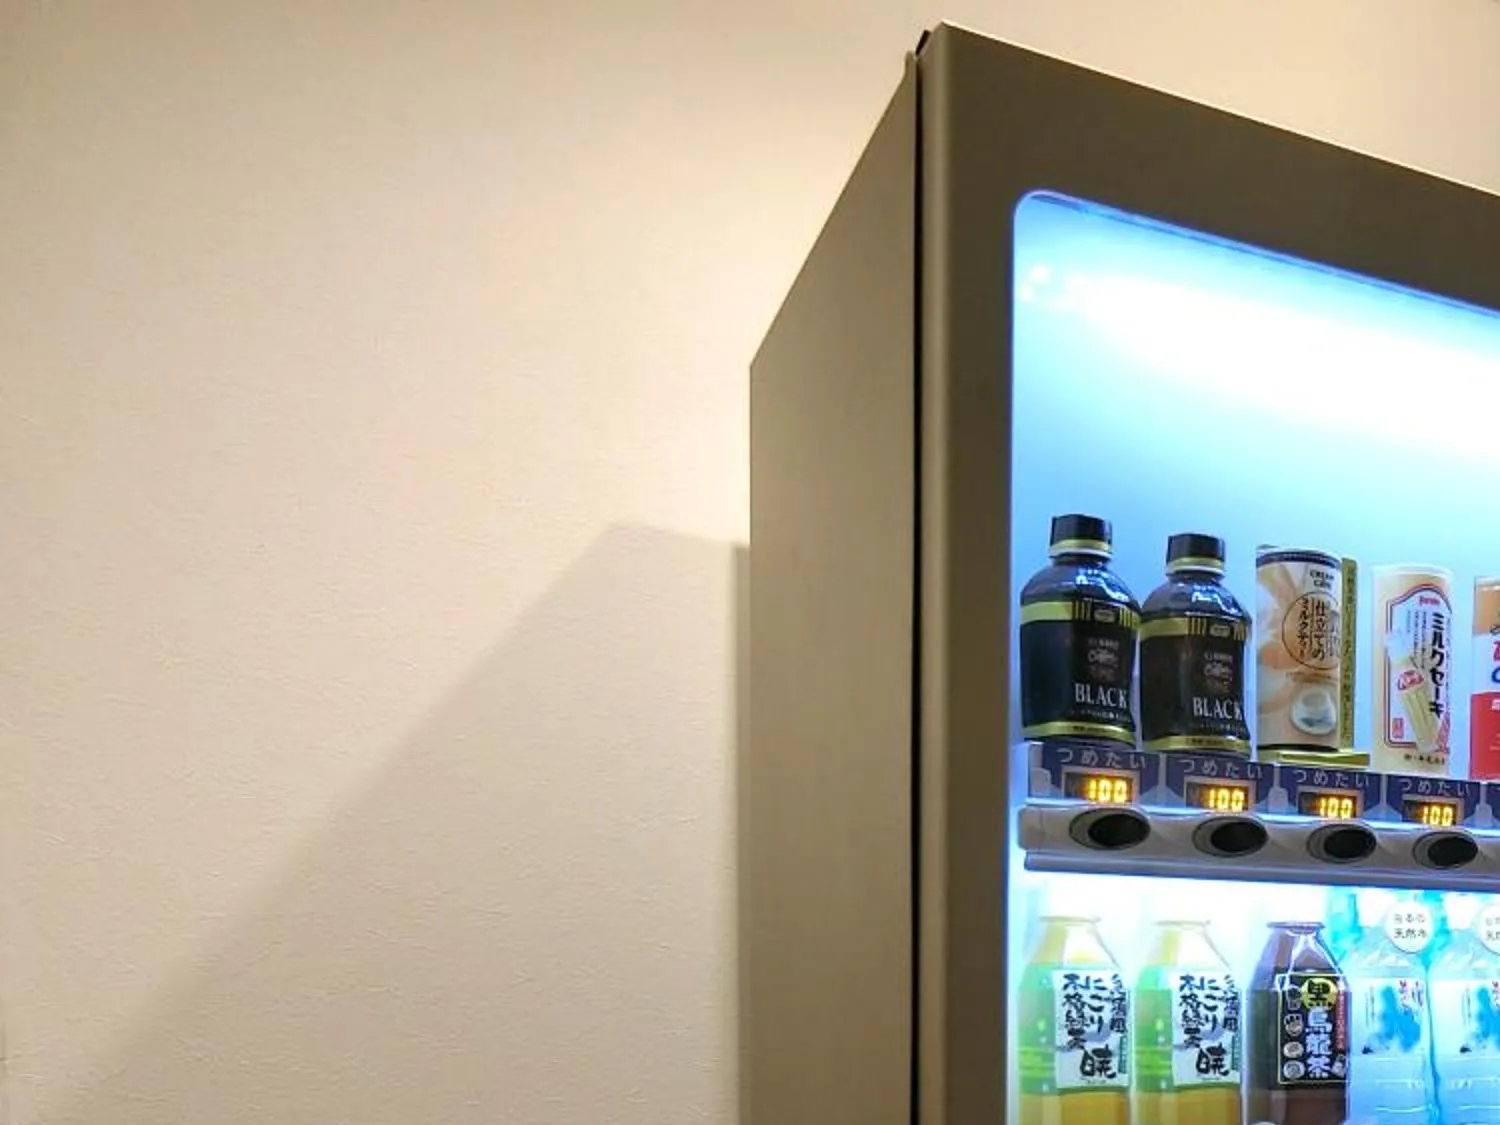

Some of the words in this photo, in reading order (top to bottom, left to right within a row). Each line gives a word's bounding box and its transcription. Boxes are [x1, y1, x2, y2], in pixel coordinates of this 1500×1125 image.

[1430, 611, 1446, 719] ミルクセーキ
[1075, 683, 1128, 709] BLACK
[1193, 697, 1243, 722] BLACK
[1057, 749, 1145, 769] つめたい
[1178, 757, 1263, 780] つめたい
[1293, 770, 1370, 788] つめたい
[1402, 778, 1470, 796] つめたい
[1088, 779, 1127, 803] 100
[1209, 789, 1245, 811] 100
[1319, 797, 1353, 818] 100
[1422, 805, 1453, 826] 100
